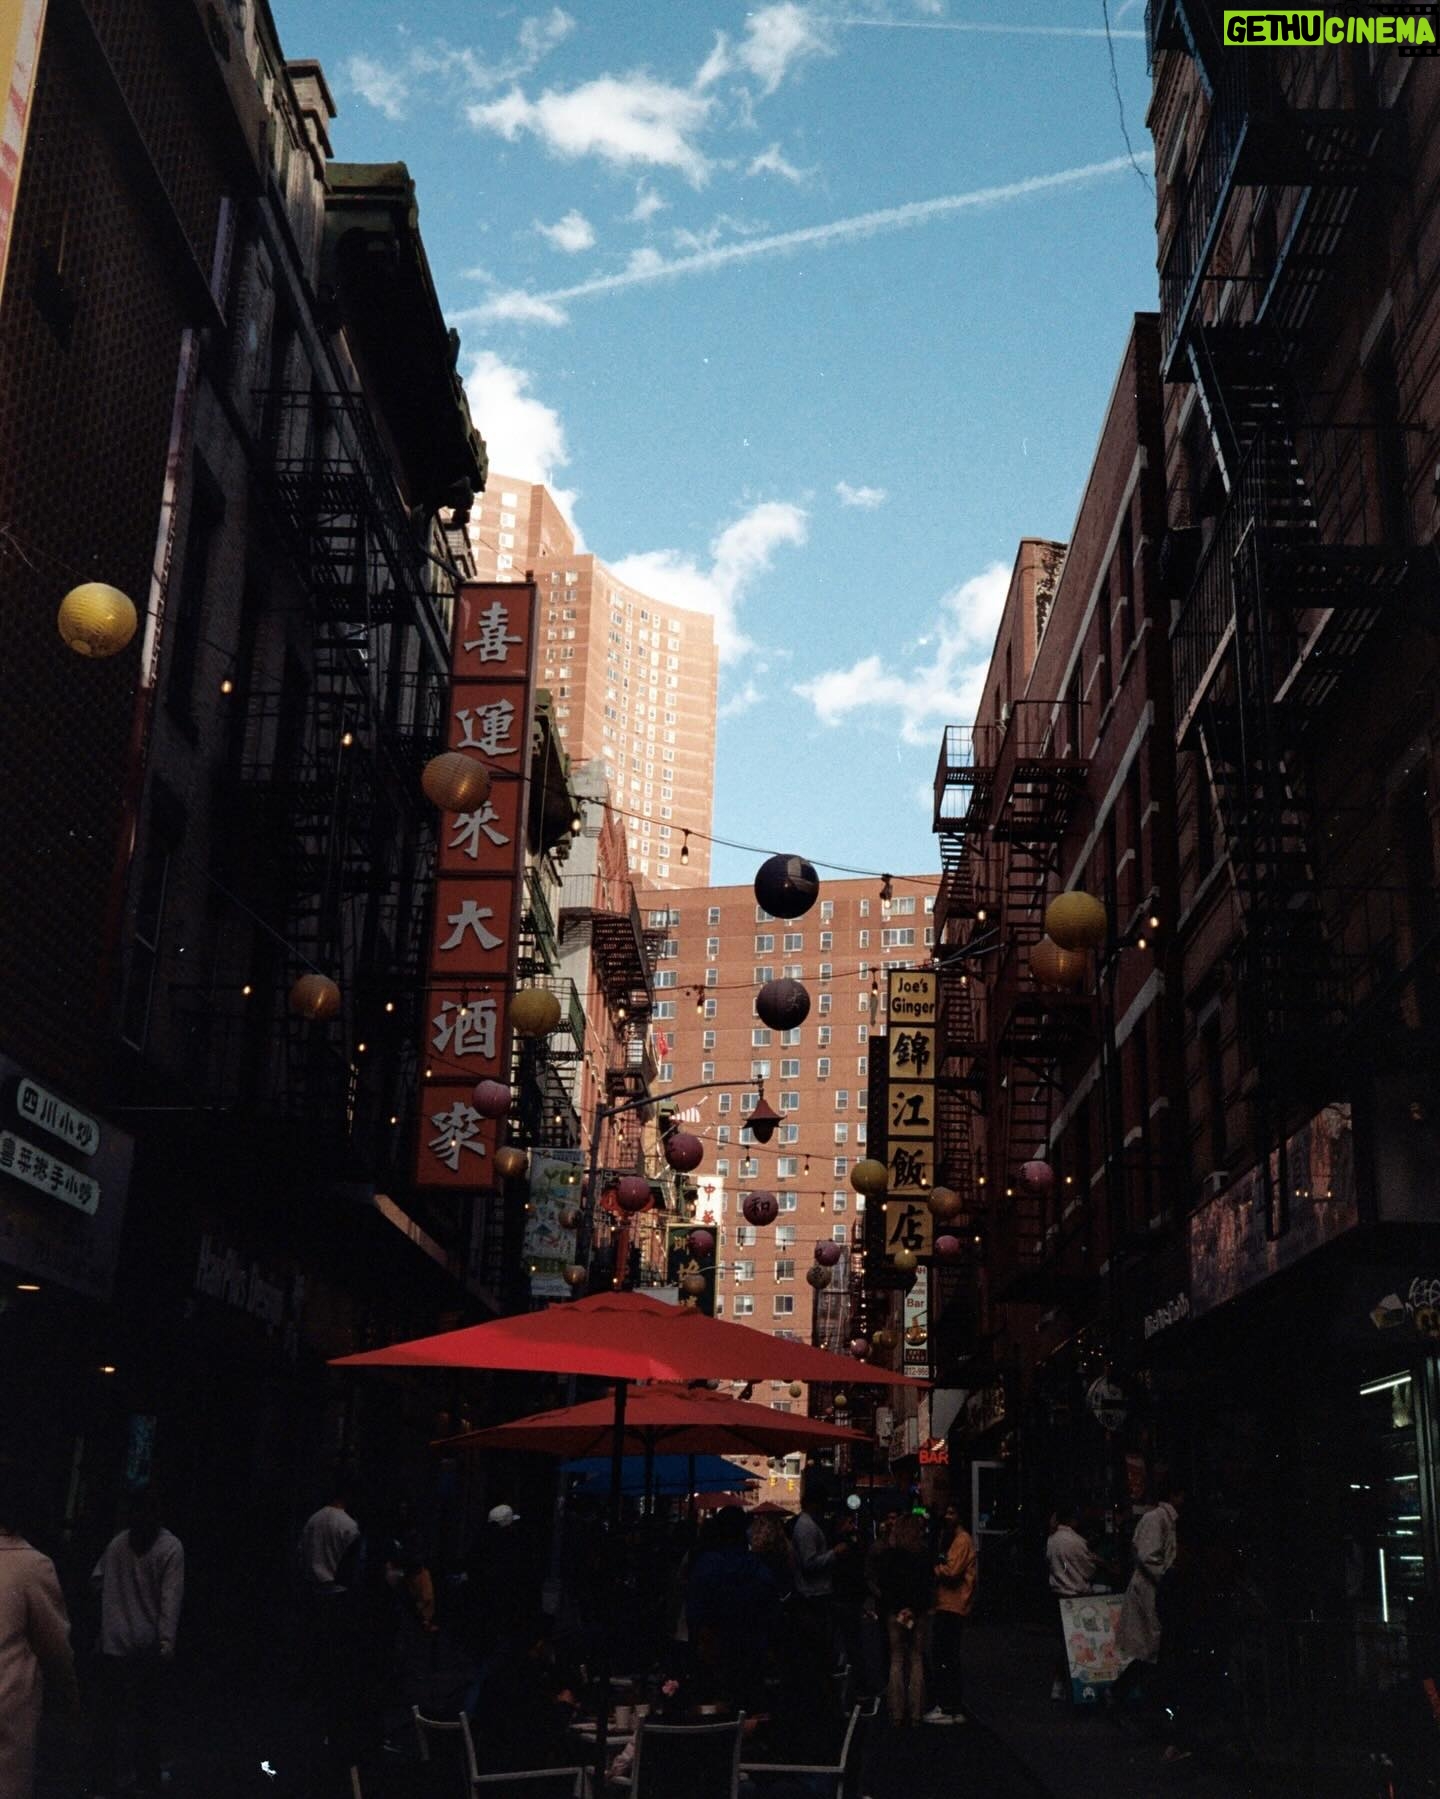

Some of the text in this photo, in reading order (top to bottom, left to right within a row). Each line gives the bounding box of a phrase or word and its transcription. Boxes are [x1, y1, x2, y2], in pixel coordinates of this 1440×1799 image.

[897, 978, 929, 993] Joe's
[891, 997, 935, 1017] Ginger
[888, 1030, 932, 1251] 錦江飯店
[906, 1298, 925, 1308] Bar
[919, 1450, 949, 1465] BAR
